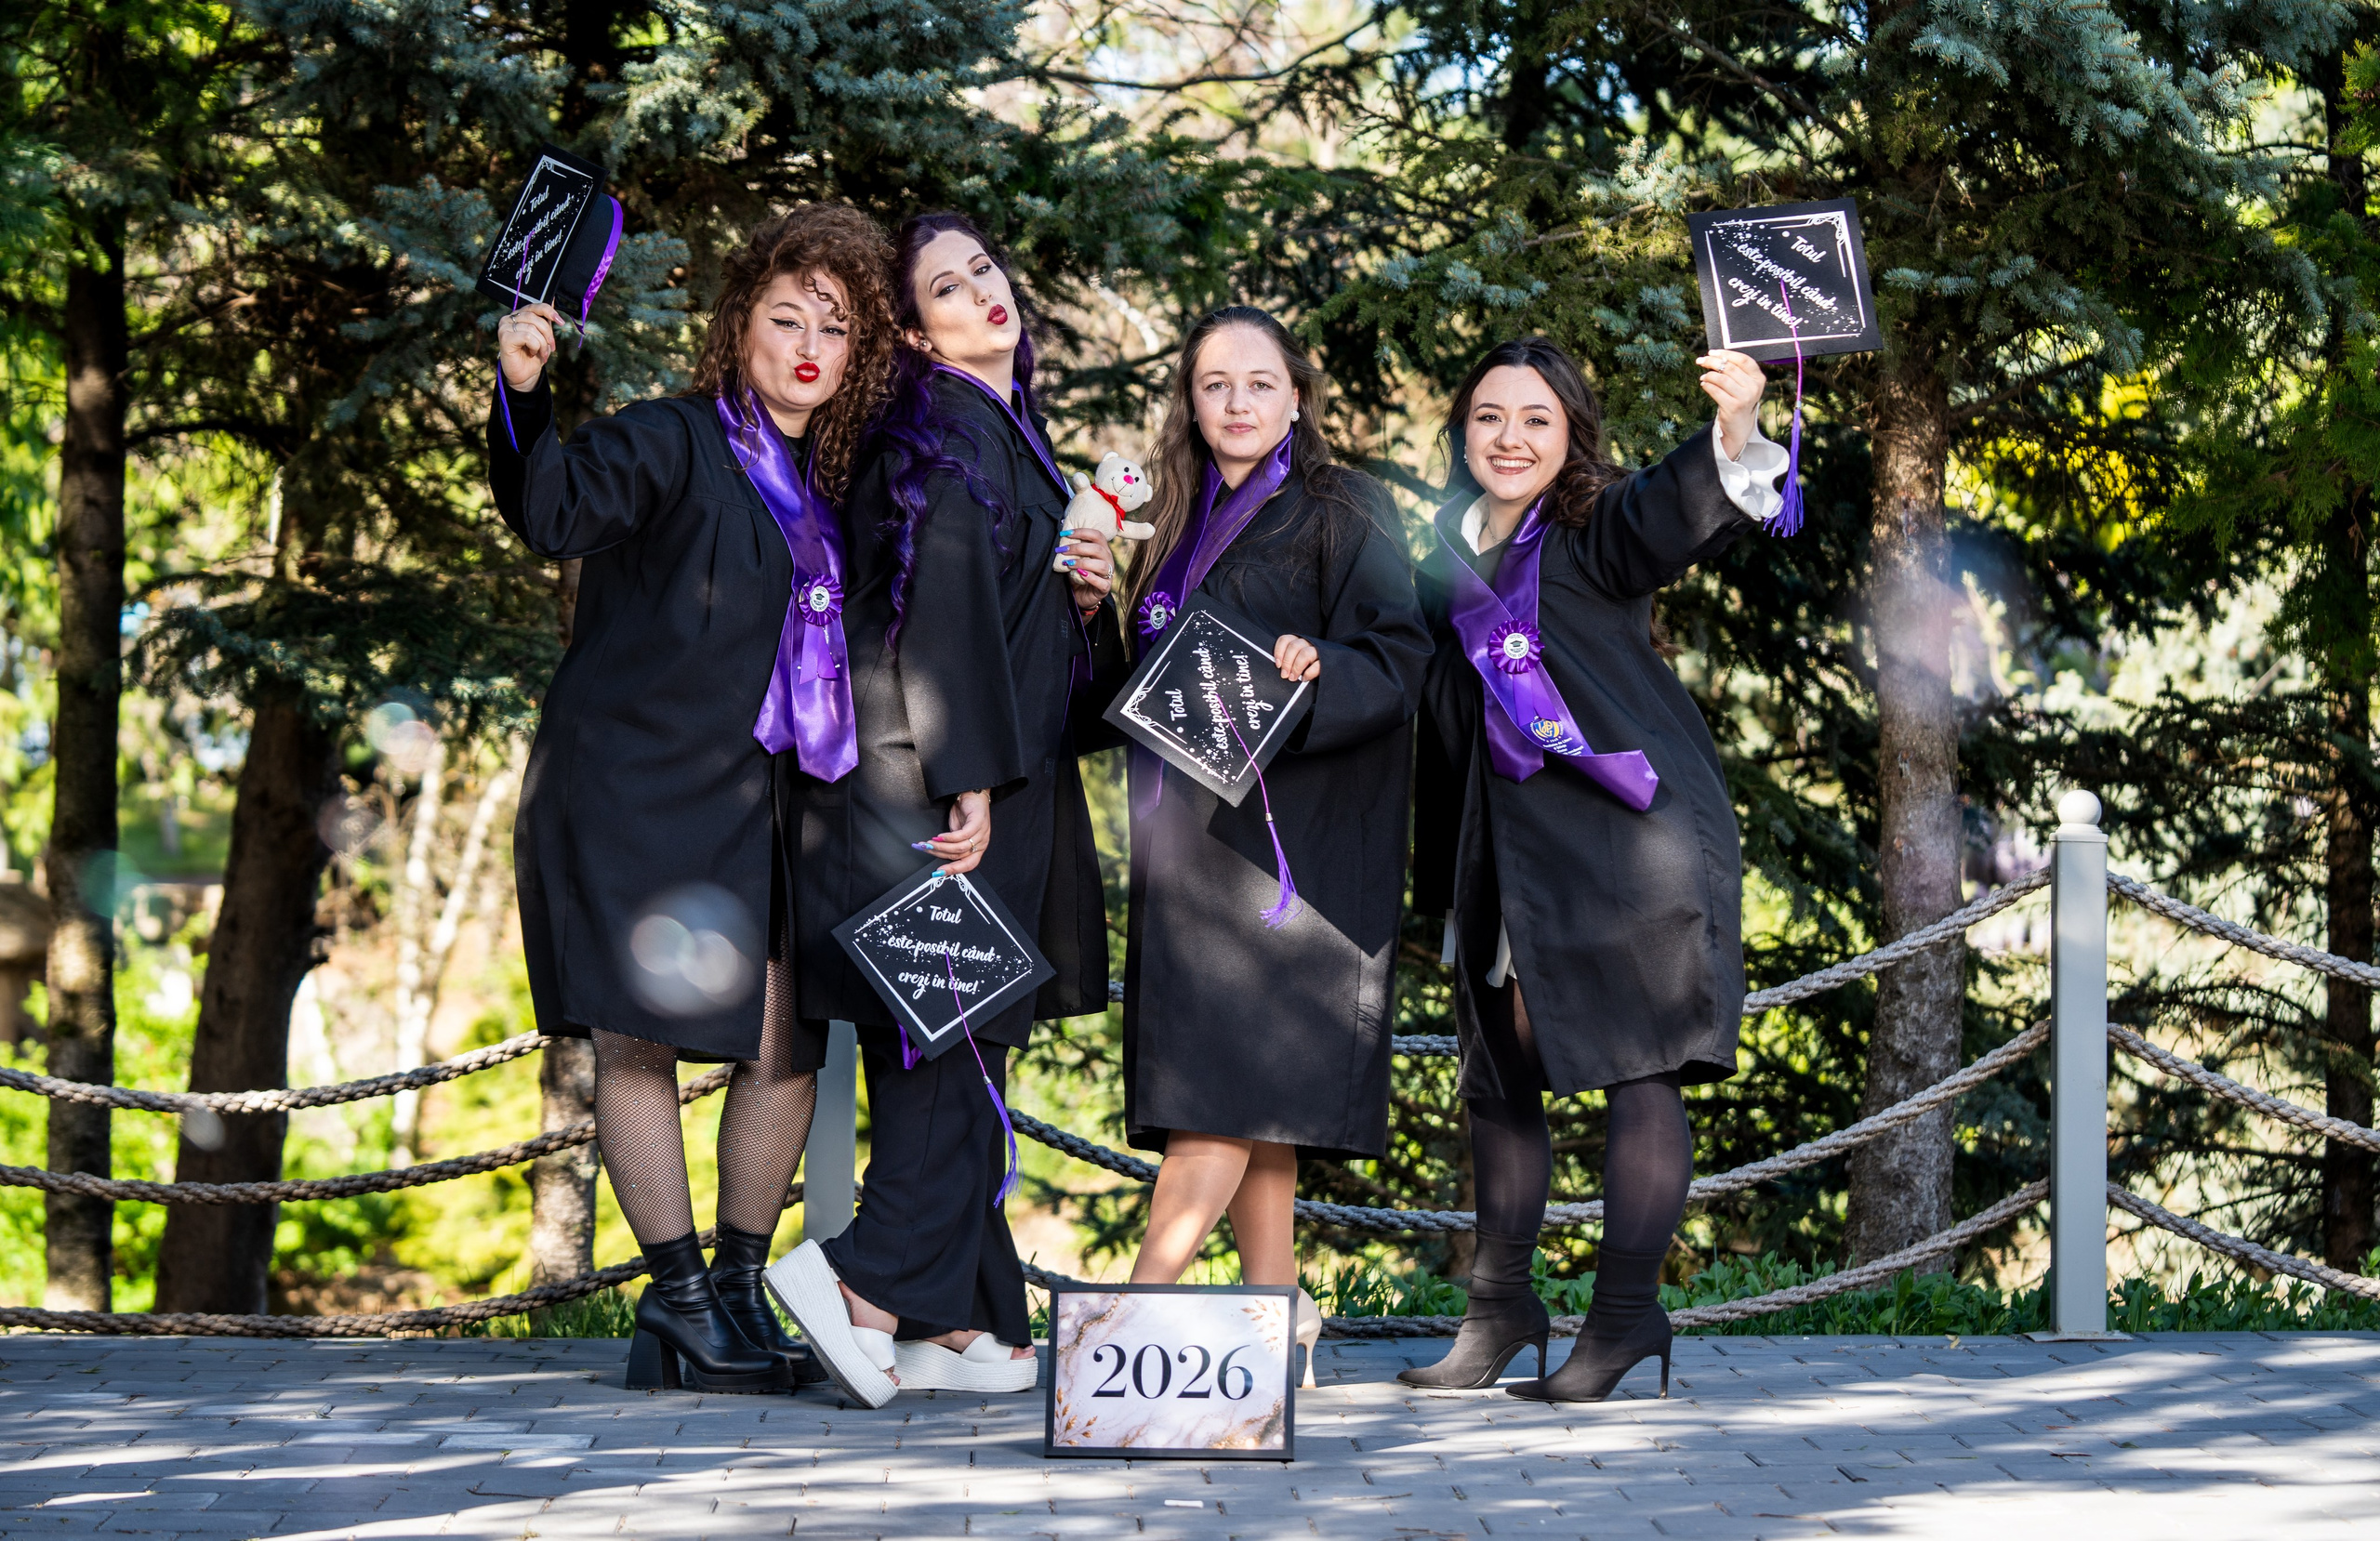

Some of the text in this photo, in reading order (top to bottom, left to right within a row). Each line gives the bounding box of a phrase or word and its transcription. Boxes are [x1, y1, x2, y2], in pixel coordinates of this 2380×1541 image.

[530, 185, 549, 213] Totul
[507, 239, 523, 259] este
[550, 192, 571, 220] când
[544, 229, 562, 254] tine!
[1790, 235, 1827, 263] Totul
[1737, 243, 1837, 310] este posibil când
[1727, 277, 1762, 308] crezi
[1756, 294, 1773, 310] în
[1164, 688, 1188, 722] Totul
[1192, 647, 1231, 750] este posibil când
[1231, 653, 1275, 731] crezi în tine!
[930, 904, 962, 924] Totul
[887, 935, 996, 962] este posibil când
[897, 971, 979, 1000] crezi în tine!
[1091, 1343, 1253, 1401] 2026
